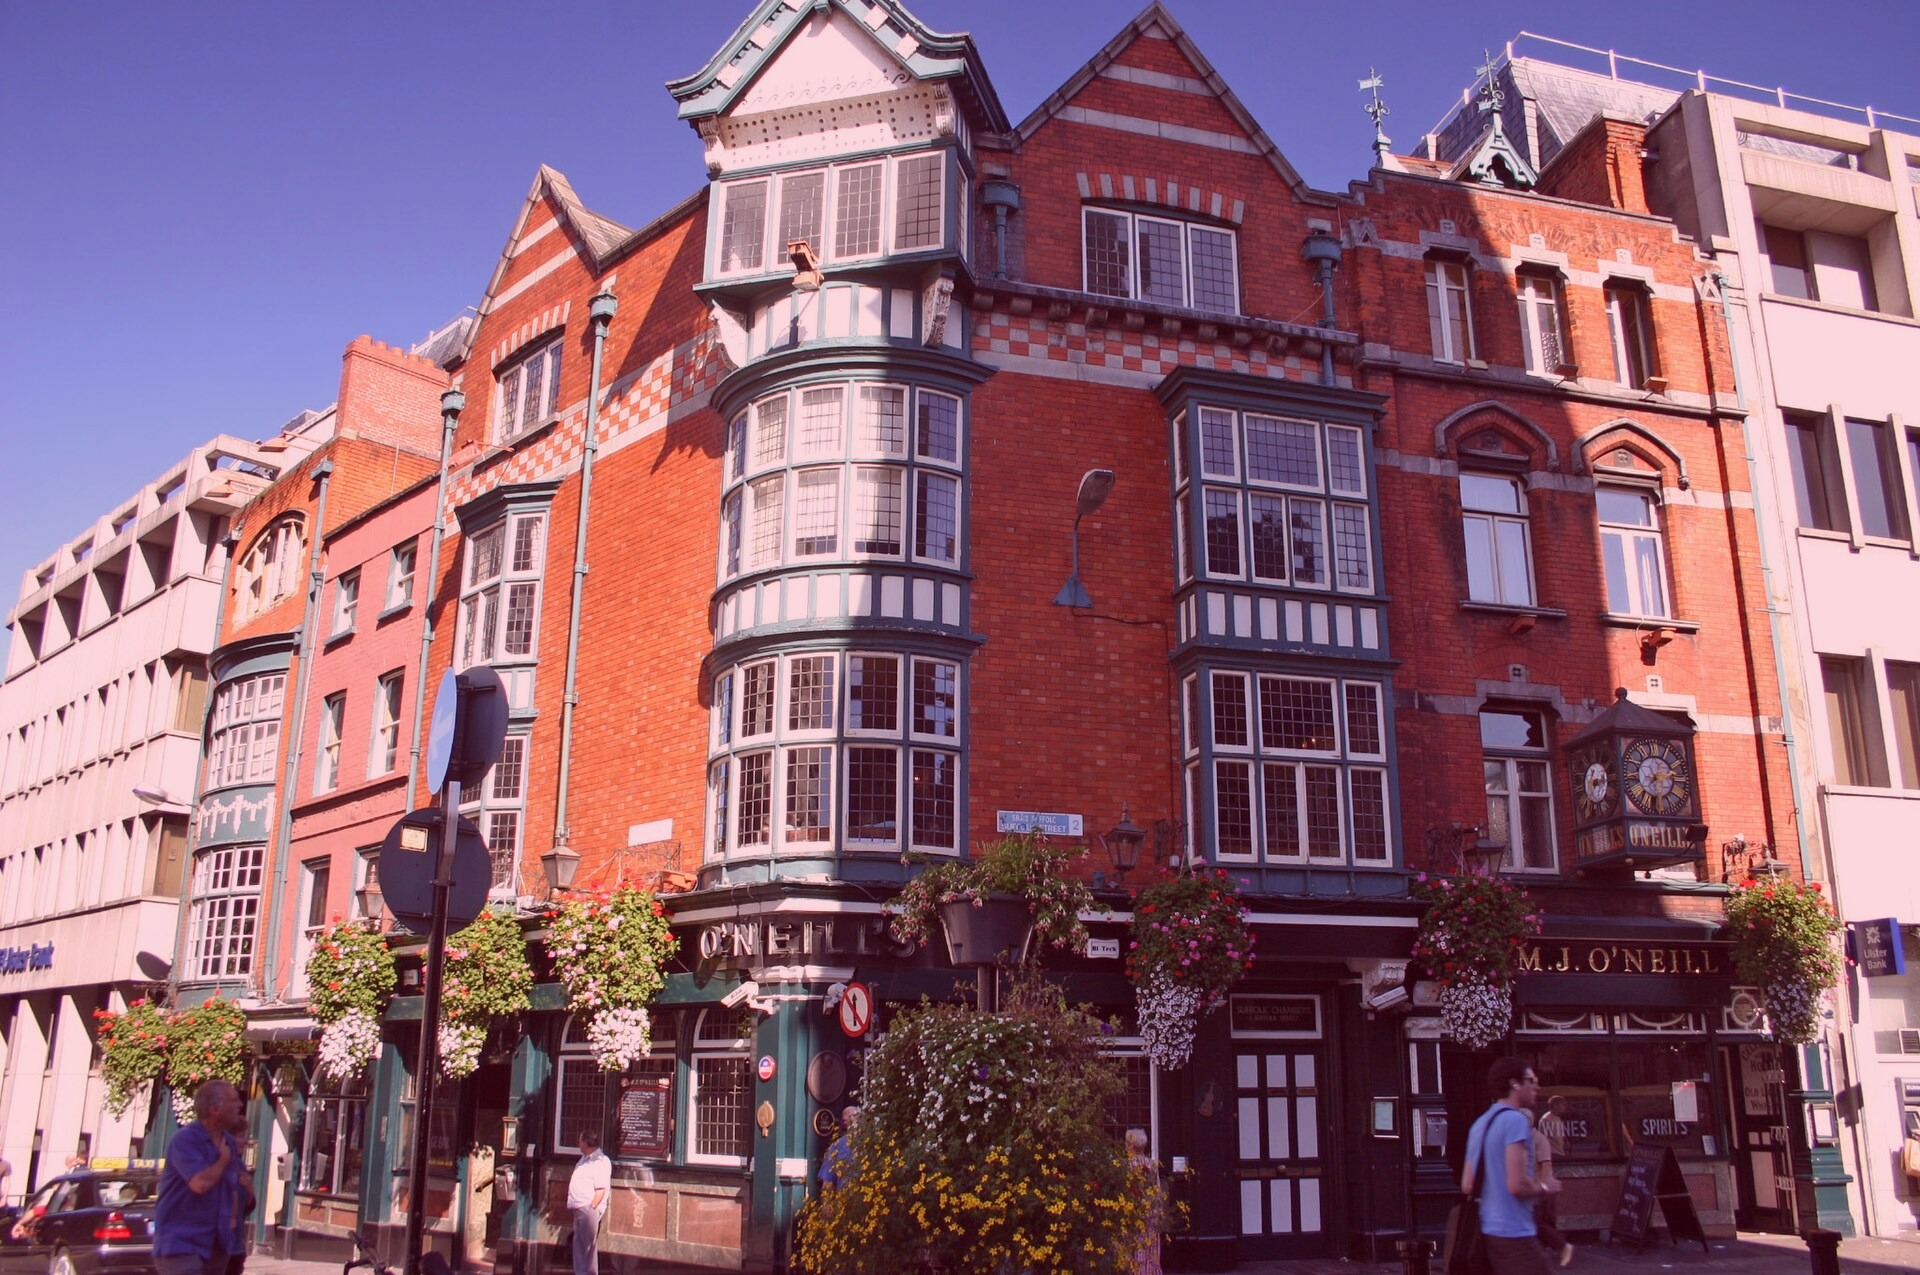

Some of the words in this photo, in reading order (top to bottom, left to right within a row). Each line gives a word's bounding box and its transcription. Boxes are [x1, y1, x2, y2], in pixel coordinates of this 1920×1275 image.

[1072, 819, 1080, 831] 2
[1515, 945, 1580, 972] M.J.
[1588, 945, 1719, 973] O'NEILL
[1863, 948, 1888, 959] Ulster
[1867, 959, 1888, 970] Bank
[1541, 1119, 1588, 1137] WINES
[132, 1158, 156, 1168] TAXI
